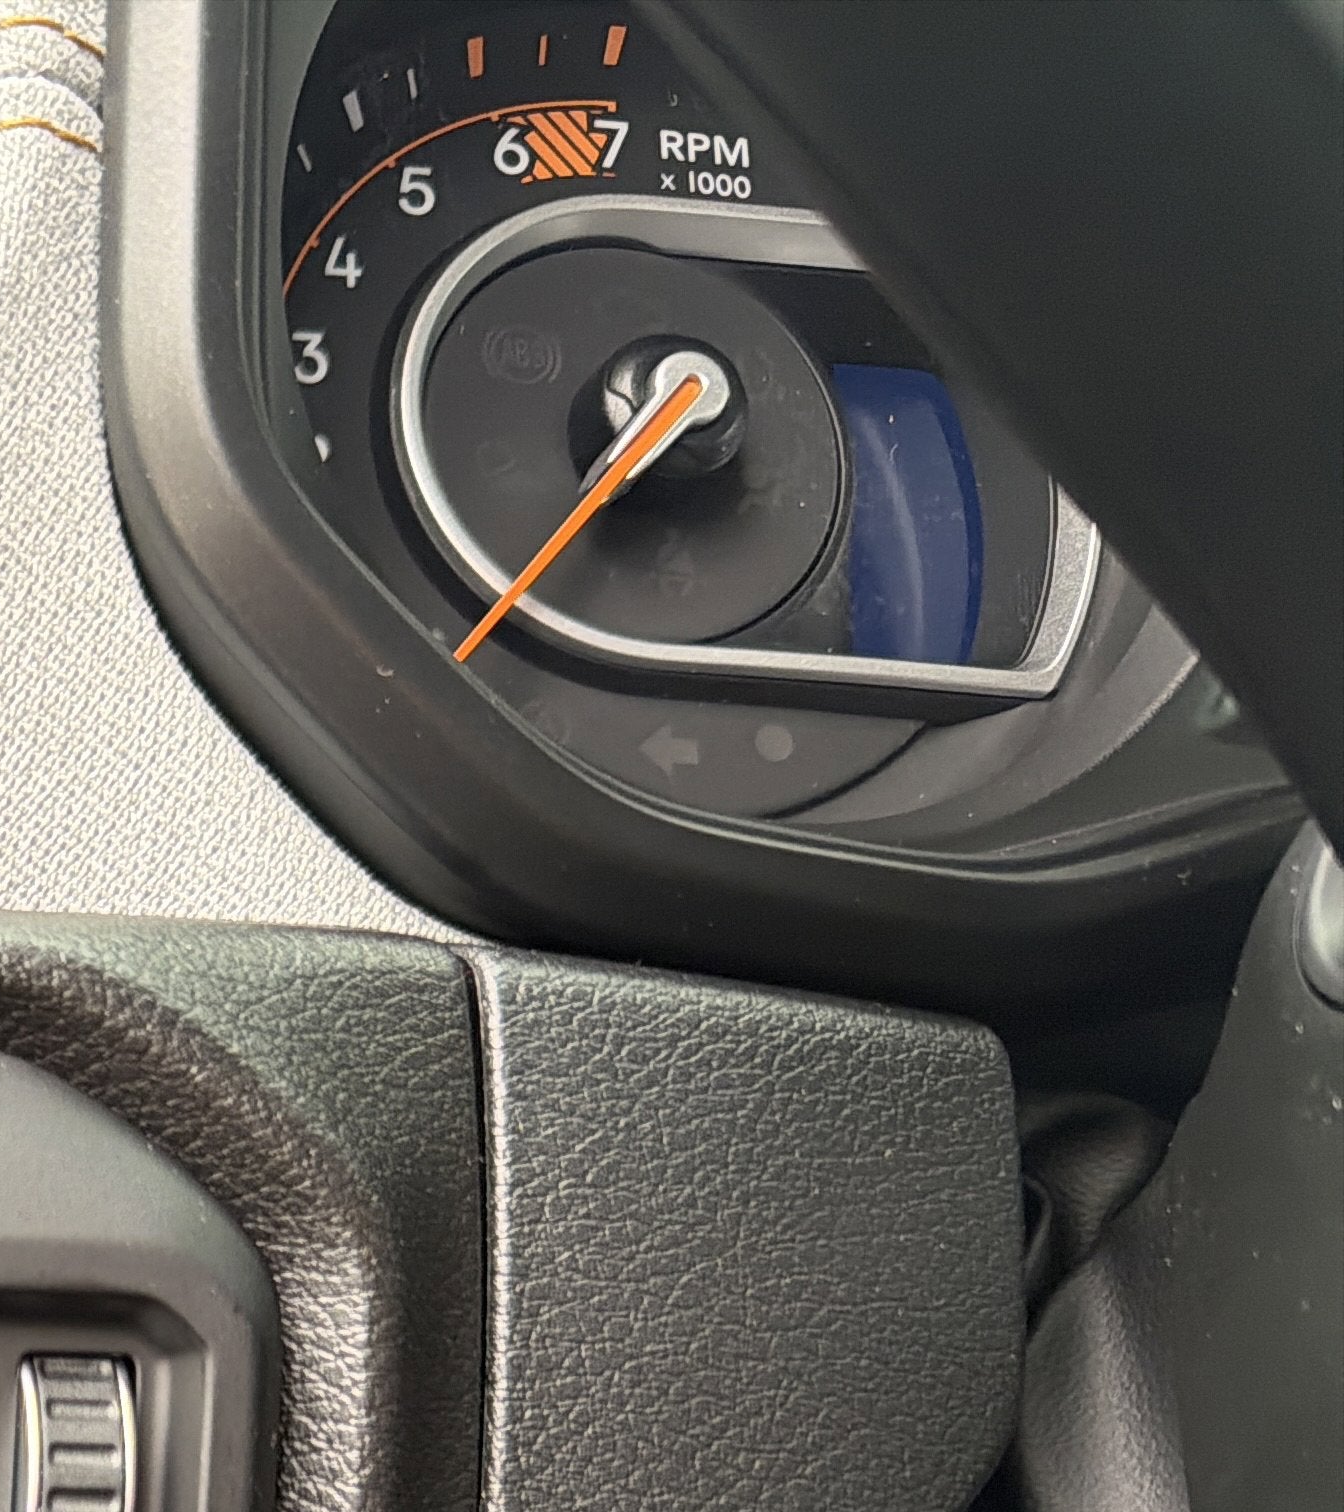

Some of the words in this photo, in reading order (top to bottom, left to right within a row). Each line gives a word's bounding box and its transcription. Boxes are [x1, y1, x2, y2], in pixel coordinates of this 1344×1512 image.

[493, 127, 530, 176] 6
[593, 119, 629, 168] 7
[659, 129, 750, 169] RPM
[398, 166, 436, 216] 5
[688, 170, 752, 200] 1000
[324, 237, 363, 289] 4
[292, 330, 330, 385] 3
